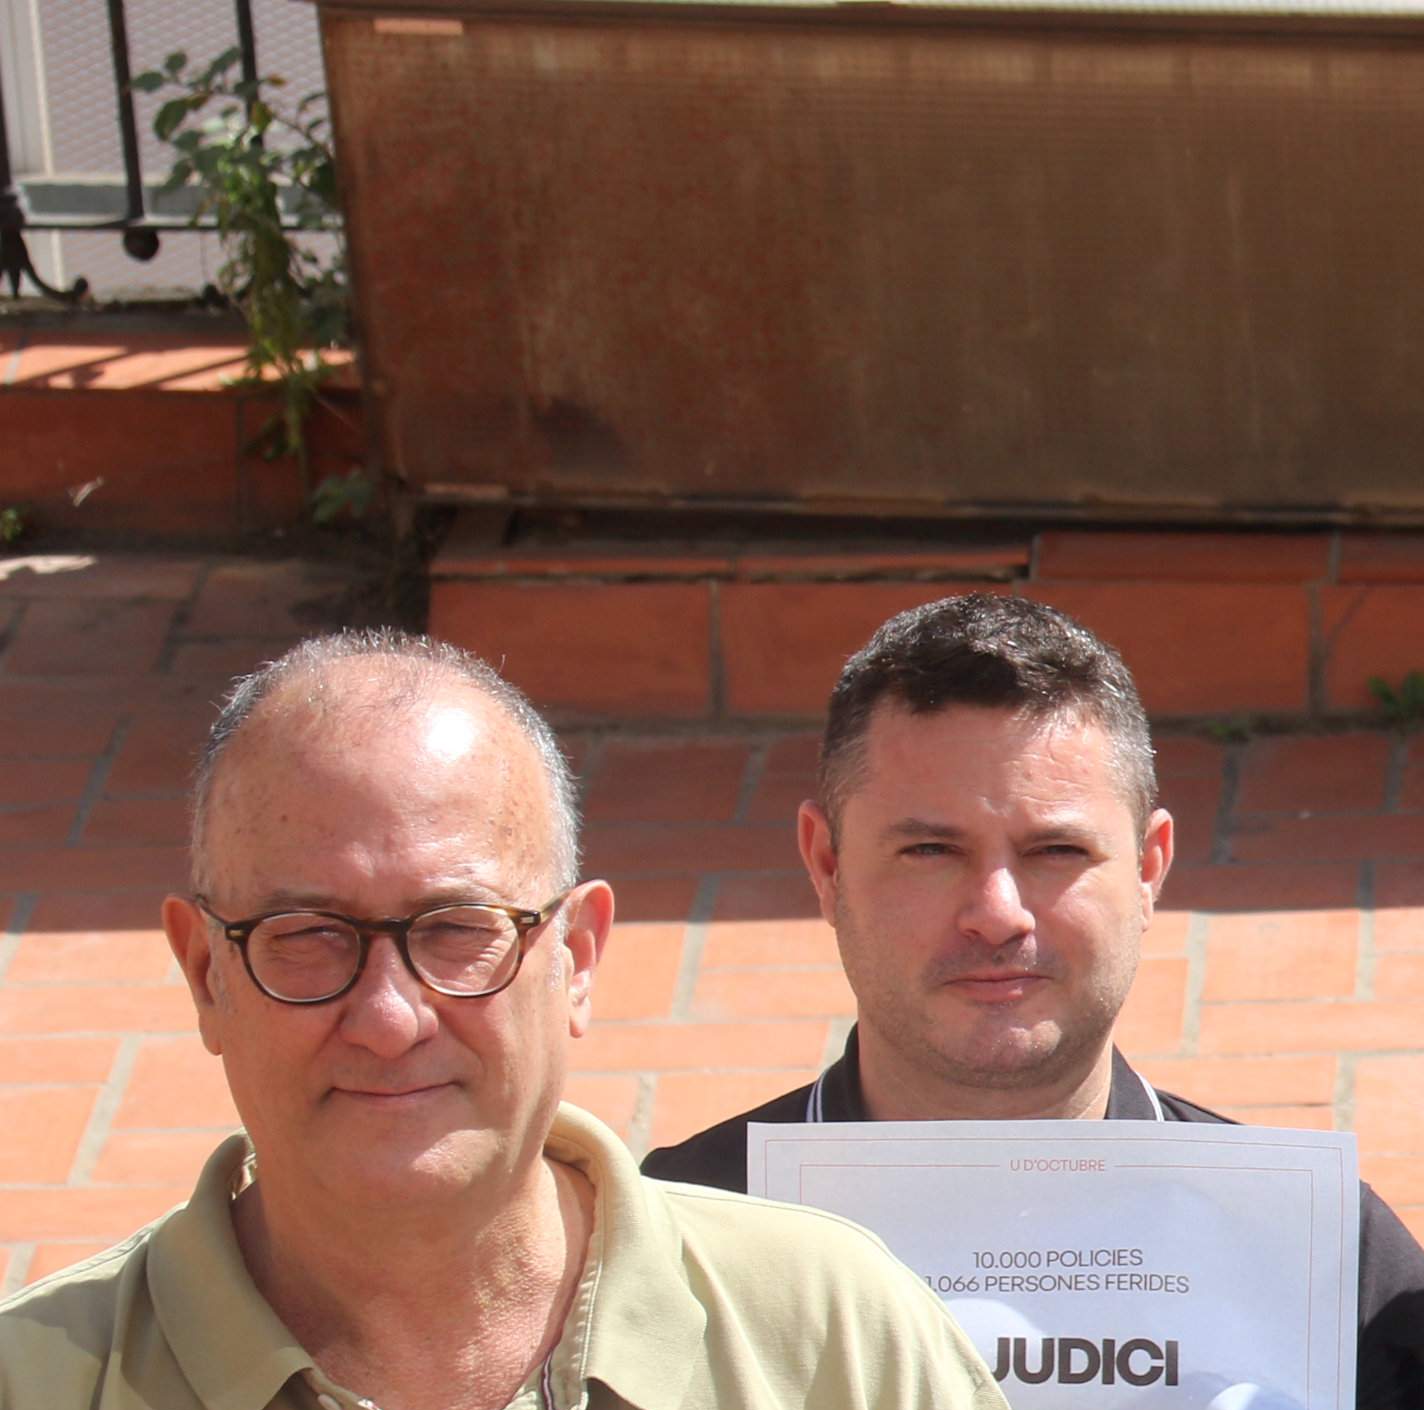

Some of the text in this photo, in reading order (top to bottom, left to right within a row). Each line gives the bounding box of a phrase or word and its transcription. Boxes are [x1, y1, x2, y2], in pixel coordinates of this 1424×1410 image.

[1010, 1160, 1105, 1171] U D'OCTUBRE
[973, 1249, 1143, 1268] 10.000 POLICIES
[985, 1274, 1100, 1292] PERSONES
[1105, 1274, 1189, 1294] FERIDES
[992, 1337, 1178, 1386] JUDICI
